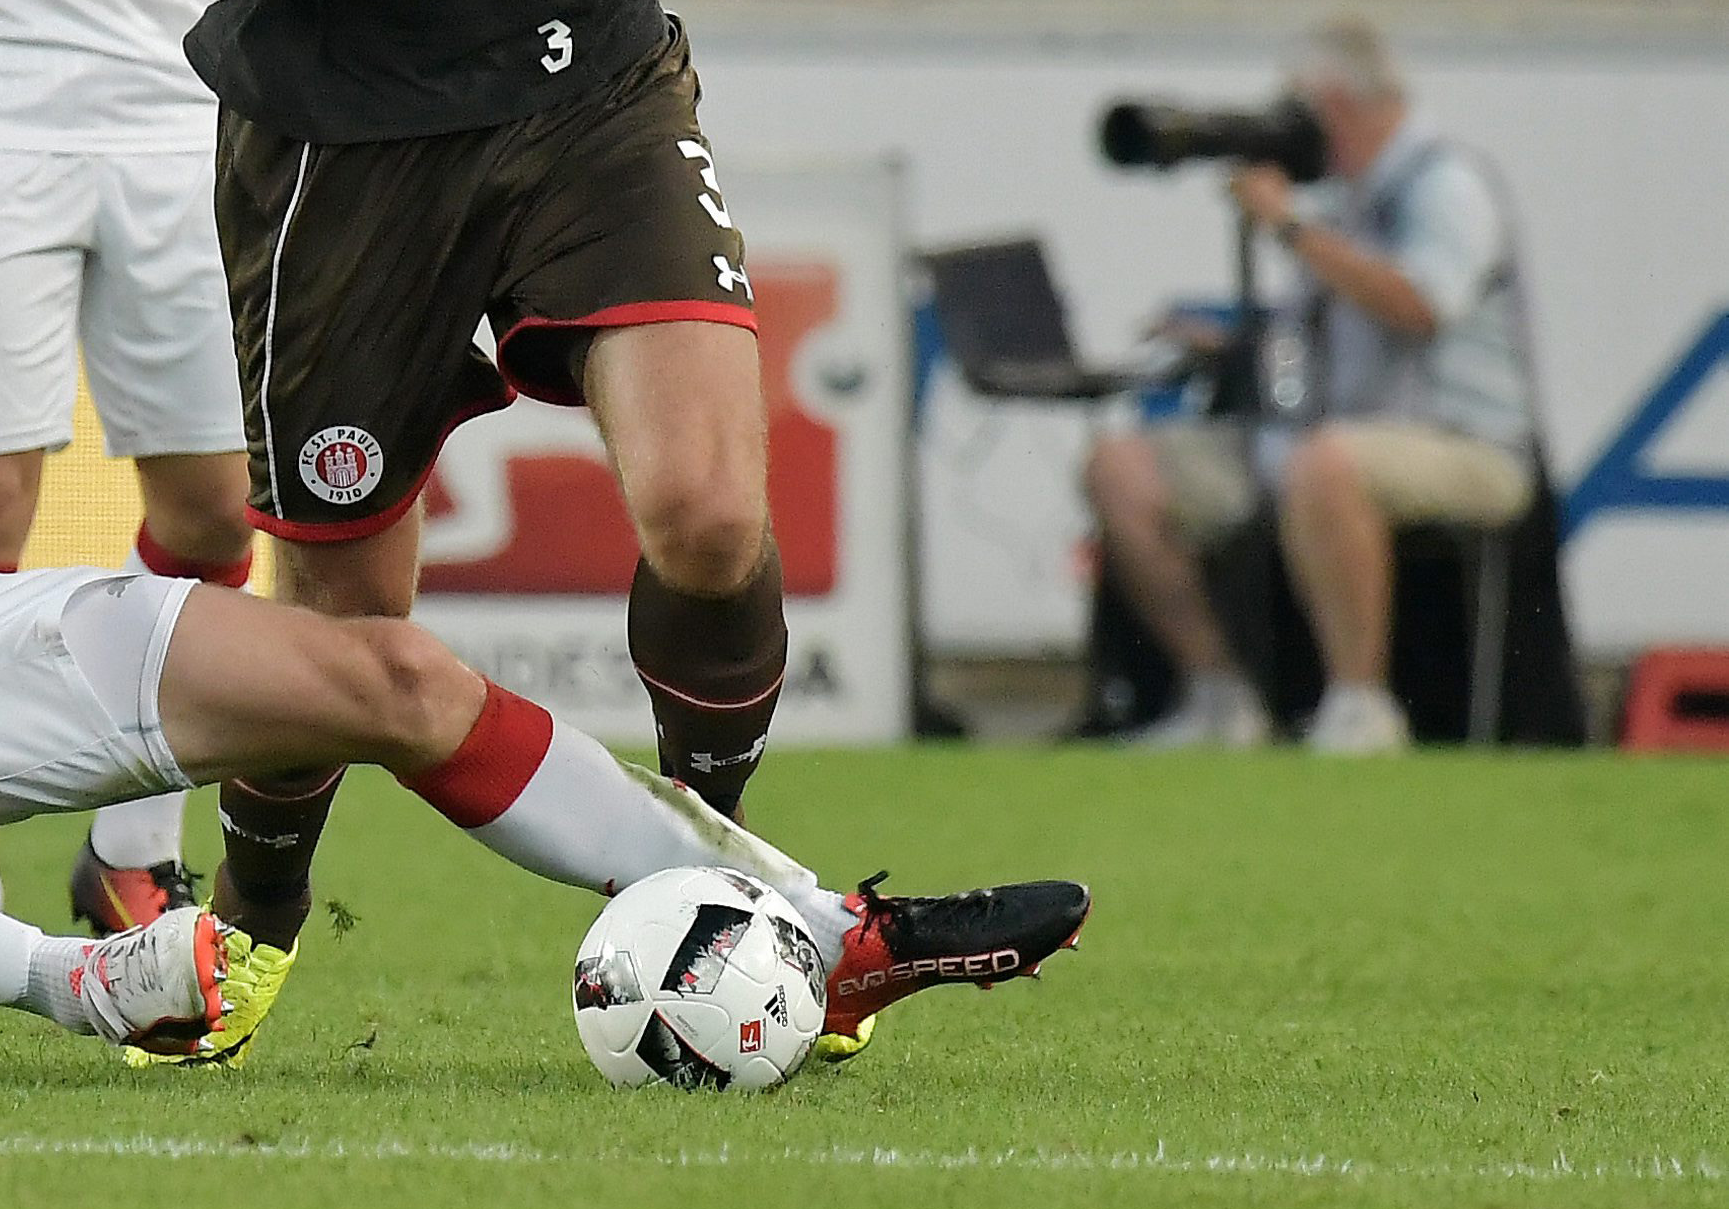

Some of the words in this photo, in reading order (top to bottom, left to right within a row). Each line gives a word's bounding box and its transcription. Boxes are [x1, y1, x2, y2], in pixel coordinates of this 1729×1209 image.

[537, 19, 573, 74] 3
[301, 450, 315, 466] FC
[311, 434, 332, 449] ST.
[337, 429, 379, 458] PAULI
[328, 488, 362, 501] 1910
[775, 984, 788, 1028] adidas
